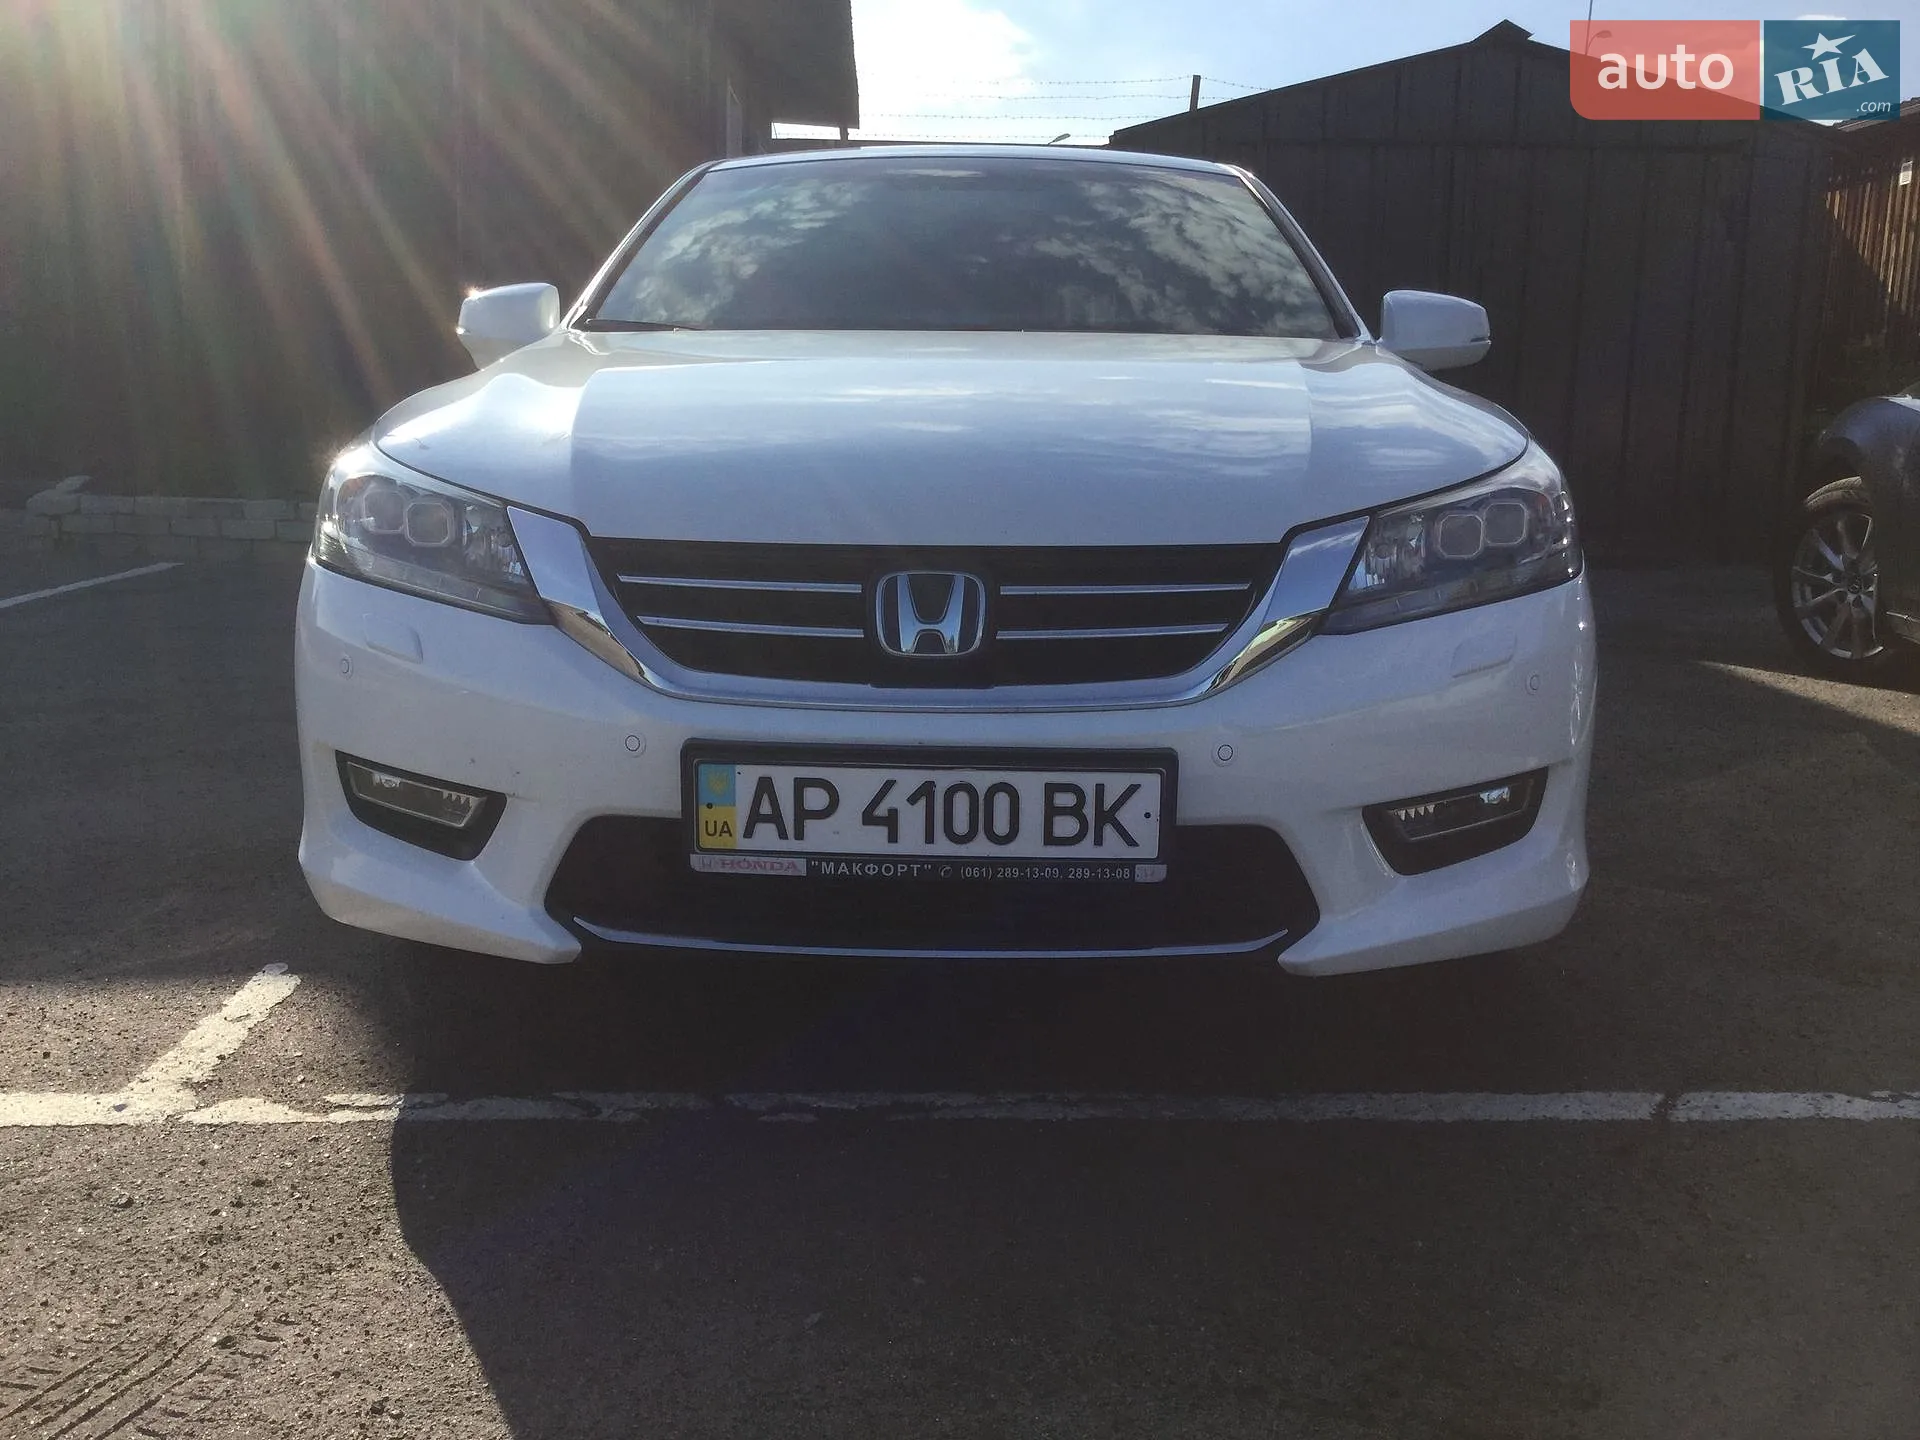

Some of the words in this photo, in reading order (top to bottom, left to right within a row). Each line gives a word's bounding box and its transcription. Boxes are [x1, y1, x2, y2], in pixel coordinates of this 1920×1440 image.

[743, 775, 840, 841] AP
[861, 779, 1021, 846] 4100
[1043, 782, 1142, 848] BK
[704, 819, 733, 838] UA
[719, 858, 800, 873] HONDA
[960, 865, 993, 880] (061)
[1068, 866, 1130, 880] 289-13-08
